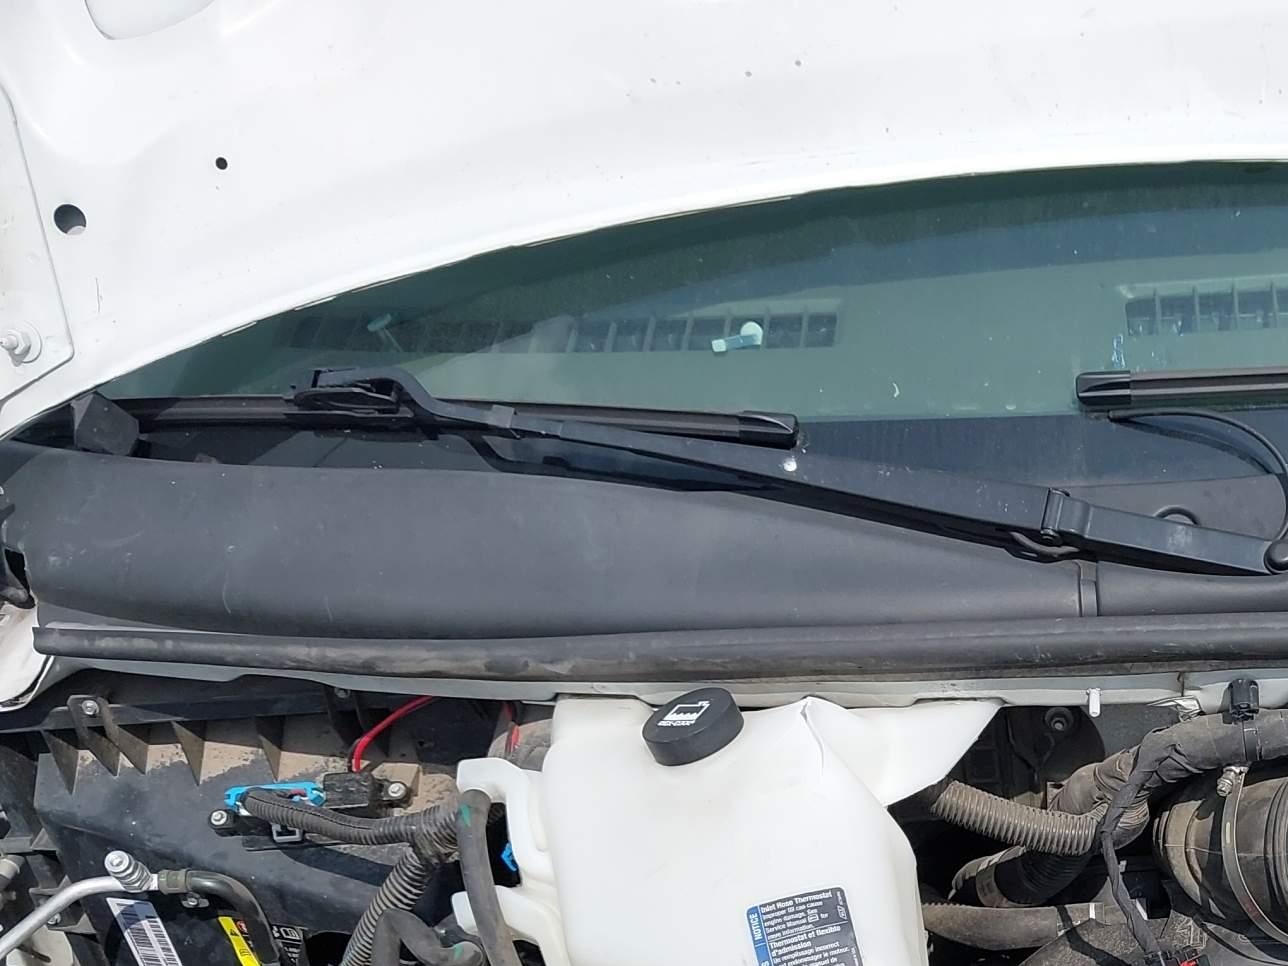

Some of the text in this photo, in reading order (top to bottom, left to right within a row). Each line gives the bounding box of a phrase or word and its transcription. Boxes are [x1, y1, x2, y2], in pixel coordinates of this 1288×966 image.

[761, 904, 776, 914] Inlet
[777, 899, 794, 909] Hose
[795, 891, 832, 904] Thermostat
[763, 910, 786, 920] Improper
[765, 918, 782, 927] engine
[749, 913, 762, 941] NOTICE
[766, 922, 786, 933] Service
[787, 918, 807, 928] Manual
[768, 932, 782, 940] more
[769, 934, 808, 949] Thermostat
[816, 926, 841, 936] flexible
[772, 941, 812, 957] d'admission
[815, 942, 840, 952] incorrect
